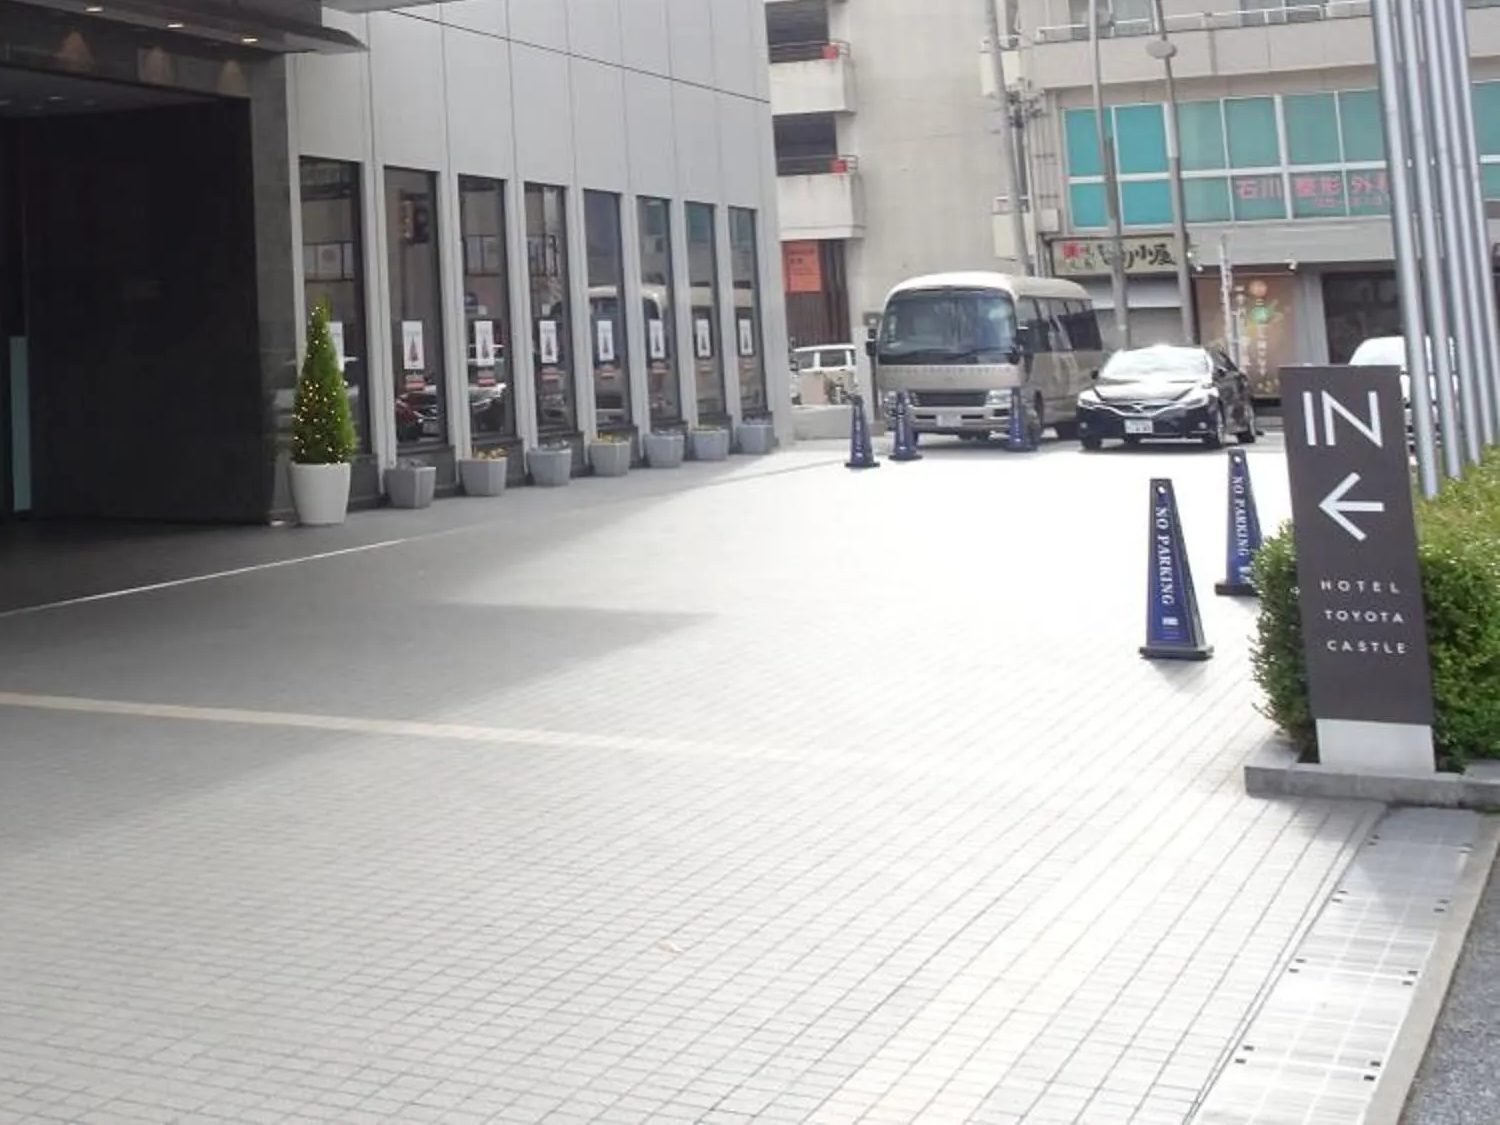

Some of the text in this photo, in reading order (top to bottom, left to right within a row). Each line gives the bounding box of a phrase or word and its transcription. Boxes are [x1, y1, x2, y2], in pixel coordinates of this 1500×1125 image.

[1303, 390, 1383, 448] IN
[1155, 506, 1170, 530] NO
[1233, 476, 1250, 557] NO PARKING
[1157, 534, 1175, 606] PARKING
[1320, 579, 1401, 594] HOTEL
[1324, 610, 1404, 623] TOYOTA
[1327, 639, 1406, 654] CASTLE
